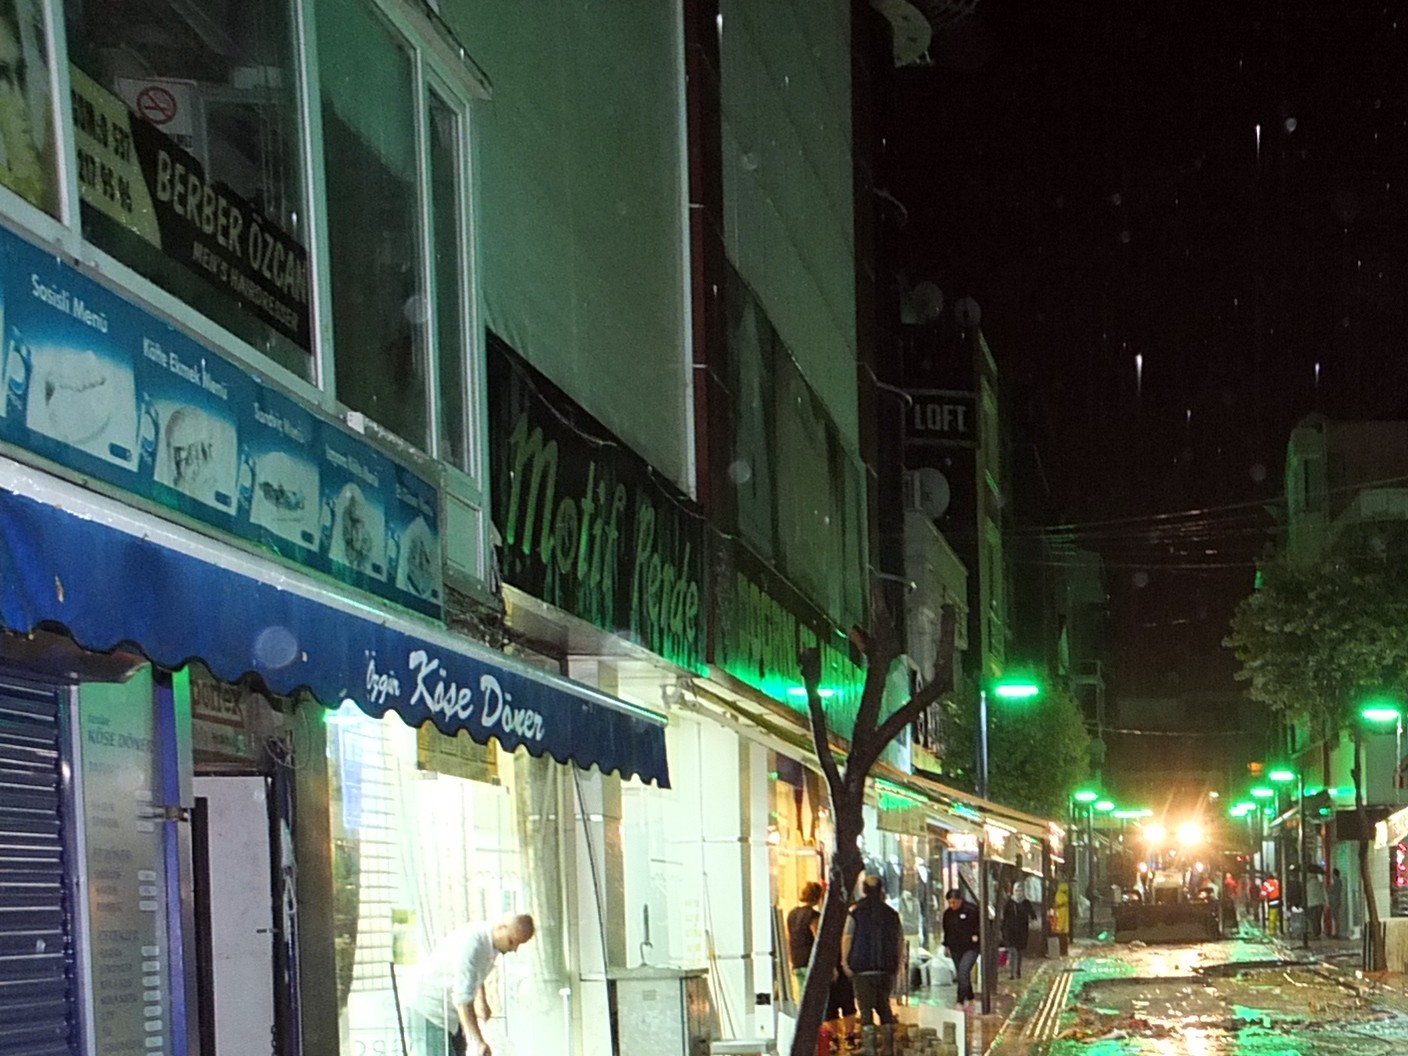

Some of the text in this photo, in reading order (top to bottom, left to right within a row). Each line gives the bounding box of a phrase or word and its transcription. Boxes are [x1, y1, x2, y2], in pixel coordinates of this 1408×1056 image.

[155, 149, 308, 304] BERBER ÖZCAN
[31, 273, 109, 333] Sosisli Menü
[914, 403, 967, 432] LOFT
[506, 411, 699, 652] Motif Perde
[408, 649, 474, 723] Köşe
[479, 674, 546, 742] Döner
